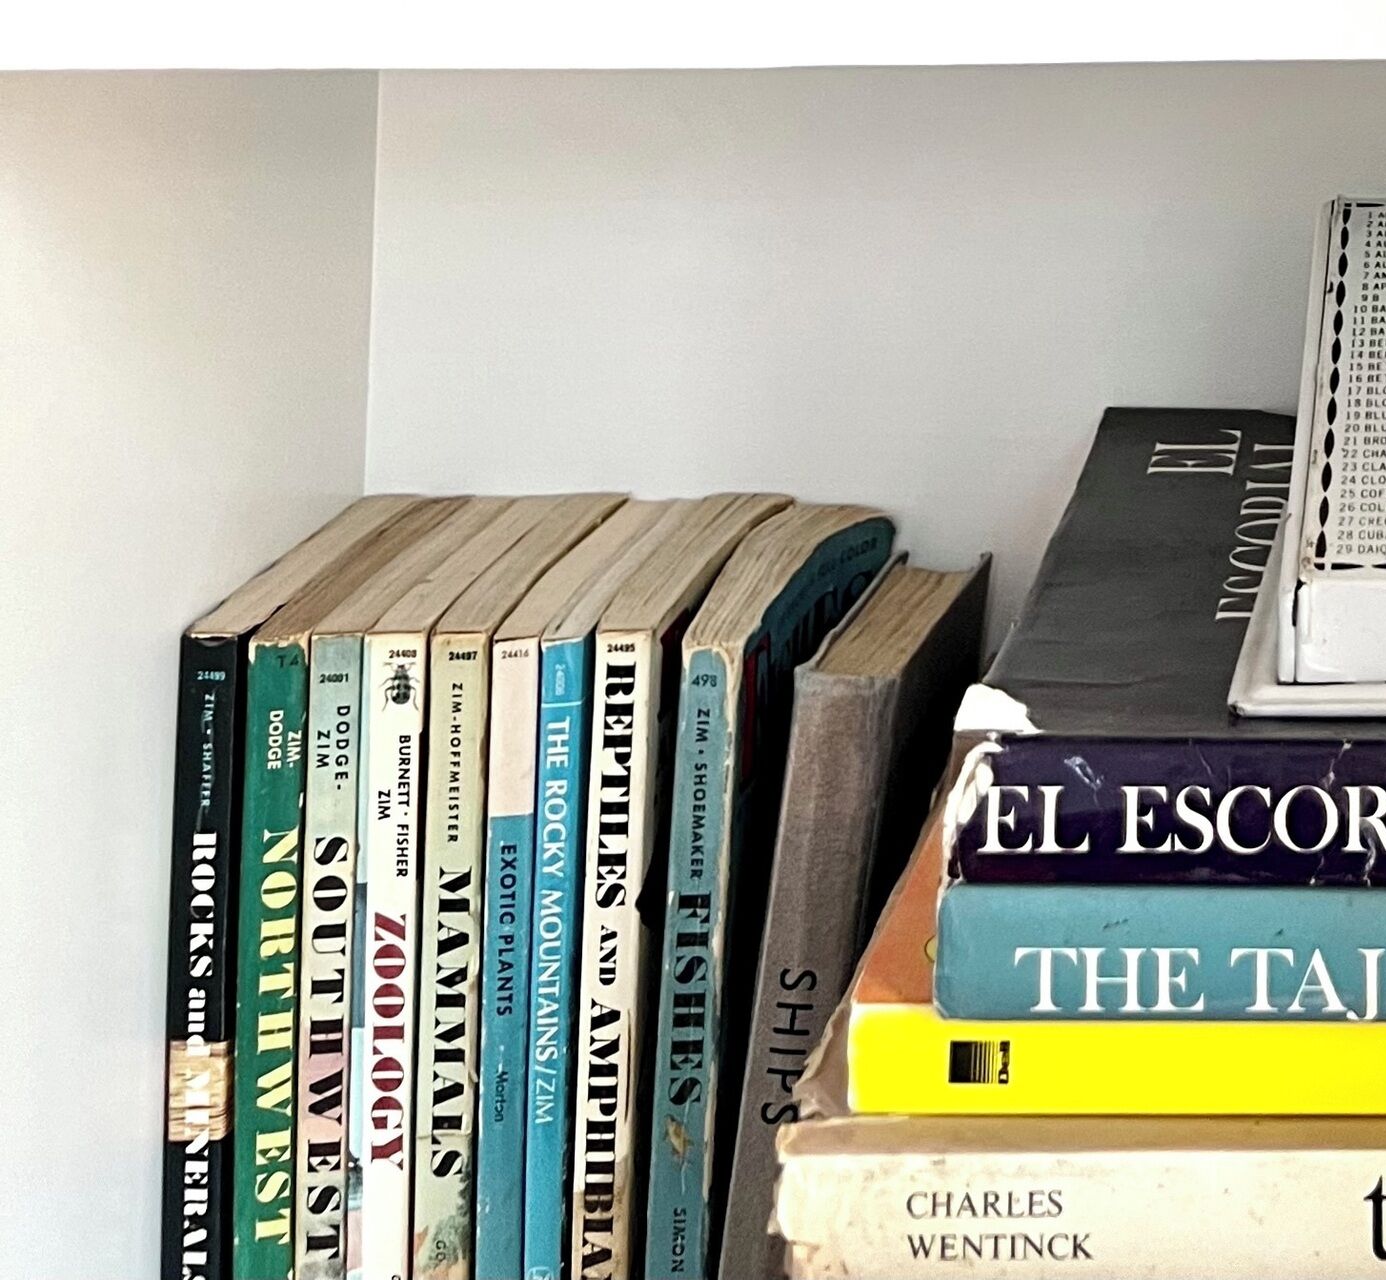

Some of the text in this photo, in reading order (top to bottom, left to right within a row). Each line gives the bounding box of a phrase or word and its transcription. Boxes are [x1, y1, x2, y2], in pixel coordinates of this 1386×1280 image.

[396, 733, 410, 878] BURNETT FISHER
[546, 716, 570, 771] THE
[979, 785, 1088, 854] EL
[542, 779, 568, 880] ROCKY
[596, 661, 638, 988] REPTILES AND
[498, 844, 516, 1016] EXOTIC PLANTS
[668, 889, 712, 1107] FISHES
[1013, 947, 1204, 1012] THE
[1230, 947, 1384, 1020] TAJ
[256, 828, 298, 1244] NORTHWEST
[306, 835, 349, 1260] SOUTHWEST
[370, 911, 408, 1171] ZOOLOGY
[431, 868, 472, 1180] MAMMALS
[906, 1190, 1063, 1219] CHARLES
[907, 1232, 1093, 1262] WENTINCK
